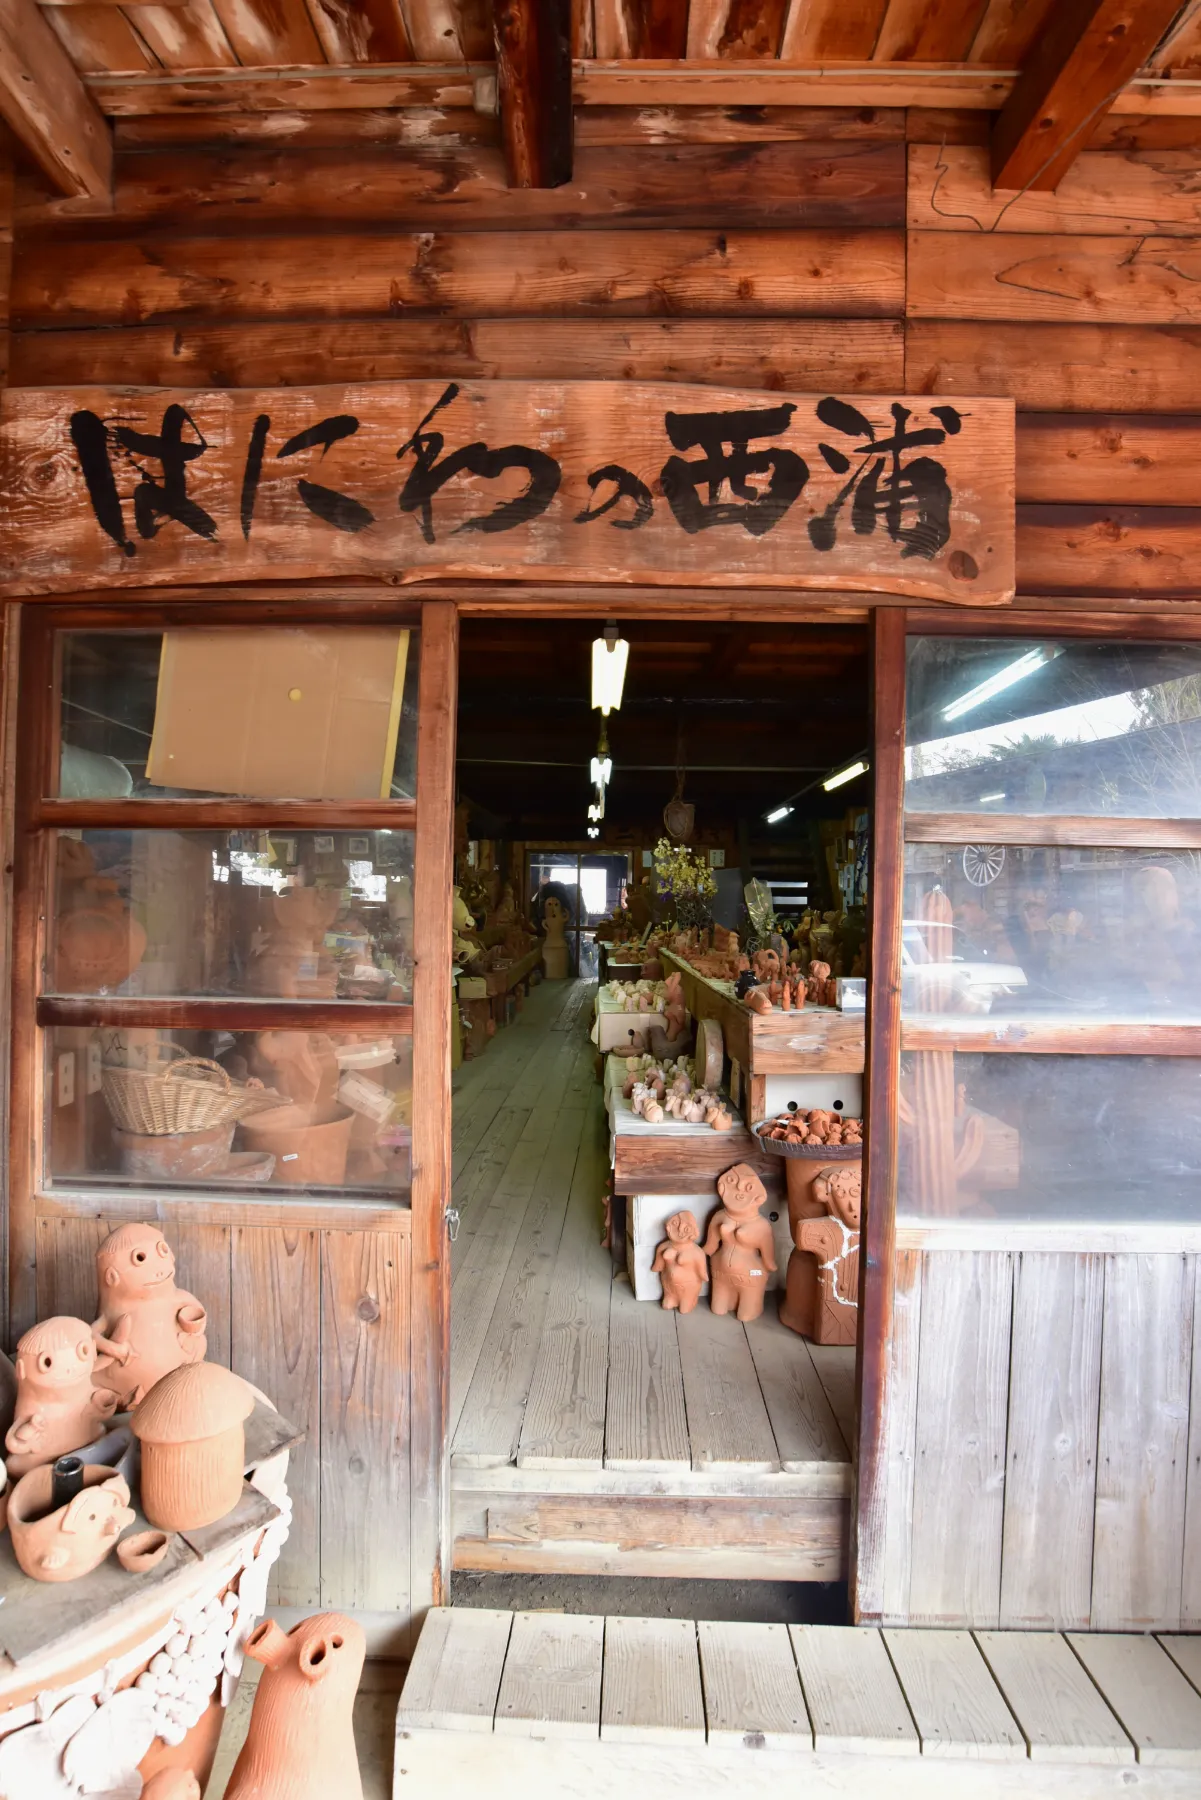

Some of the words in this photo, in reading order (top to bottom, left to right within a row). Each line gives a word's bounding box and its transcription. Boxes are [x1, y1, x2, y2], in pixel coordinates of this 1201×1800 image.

[70, 383, 964, 560] はにわの西浦
